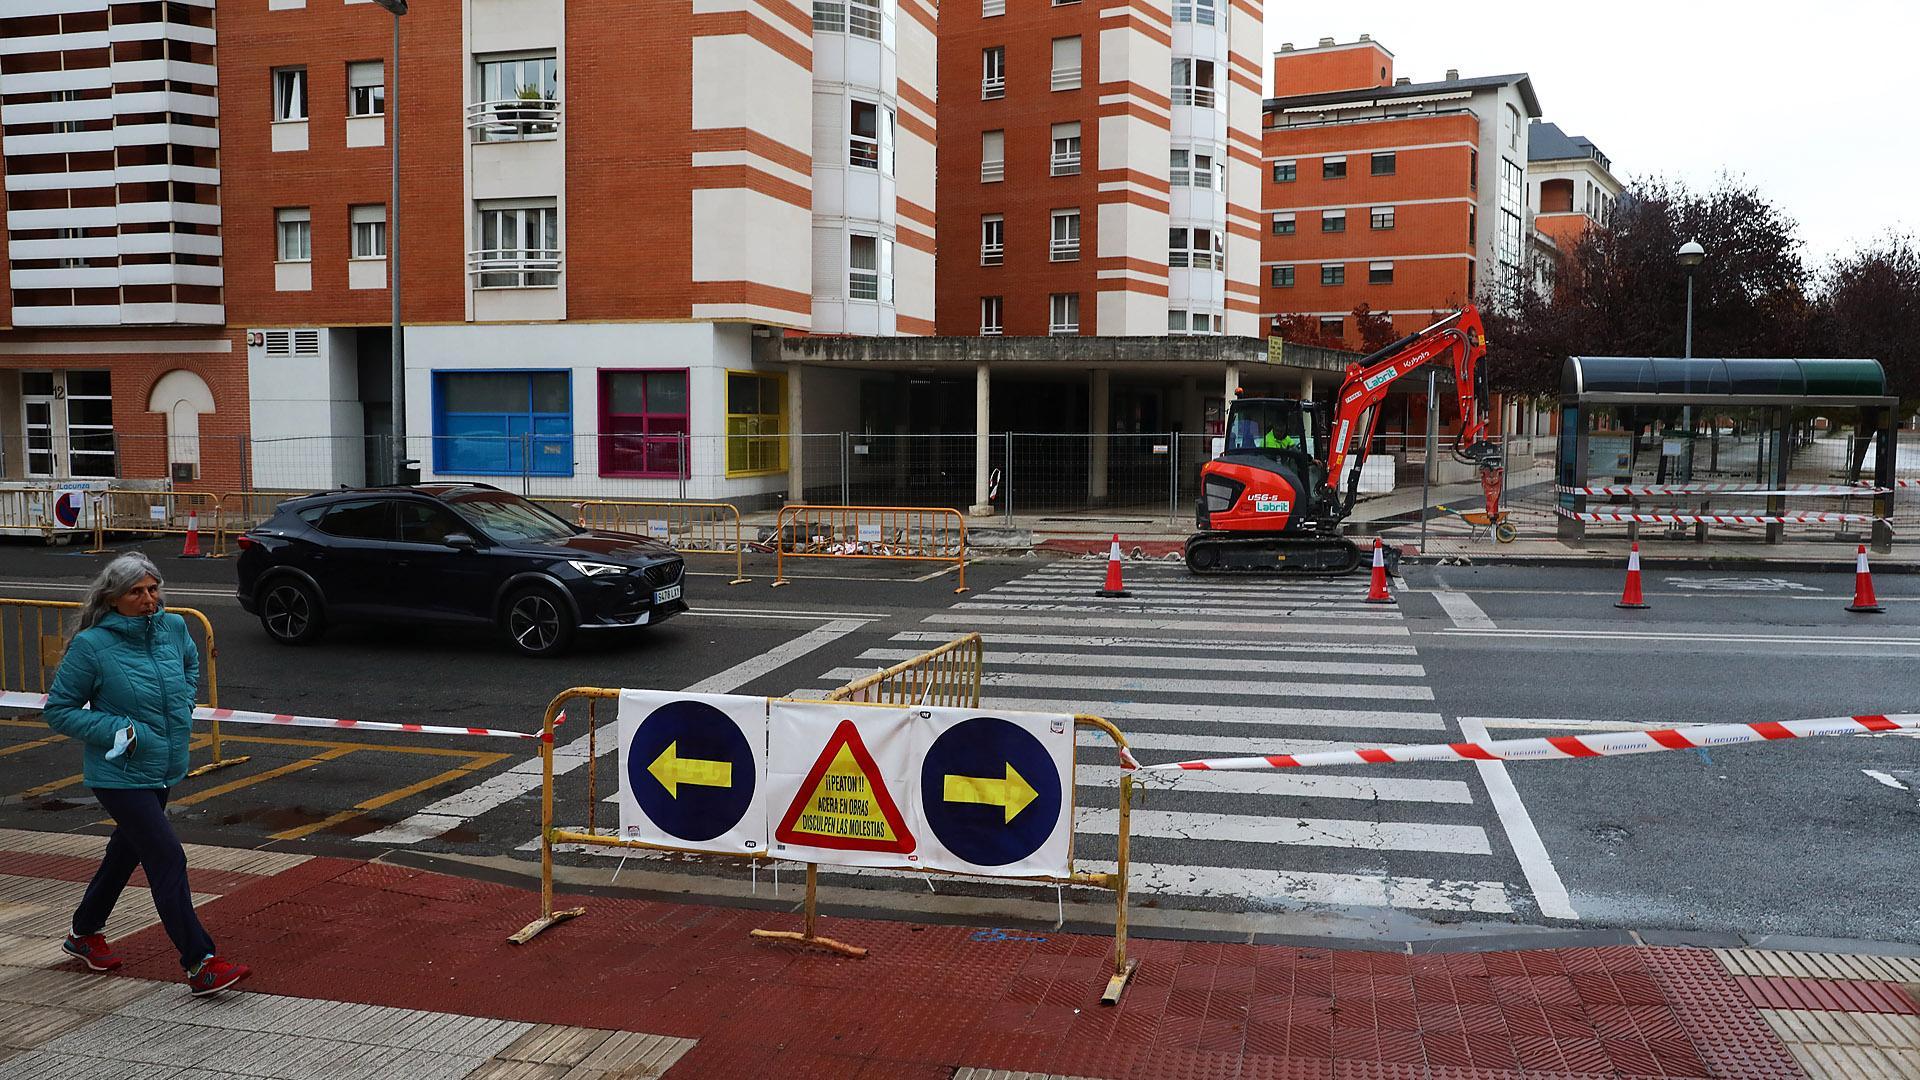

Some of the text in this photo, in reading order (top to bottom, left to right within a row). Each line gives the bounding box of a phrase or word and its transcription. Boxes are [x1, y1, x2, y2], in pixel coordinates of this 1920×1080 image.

[1403, 351, 1430, 368] Kubota
[1365, 367, 1397, 390] Labrit
[54, 385, 65, 400] 12
[1257, 502, 1288, 512] Labrit
[818, 797, 869, 817] ACERA EN OBRAS
[802, 815, 885, 838] DISCULPEN LAS MOLESTIAS
